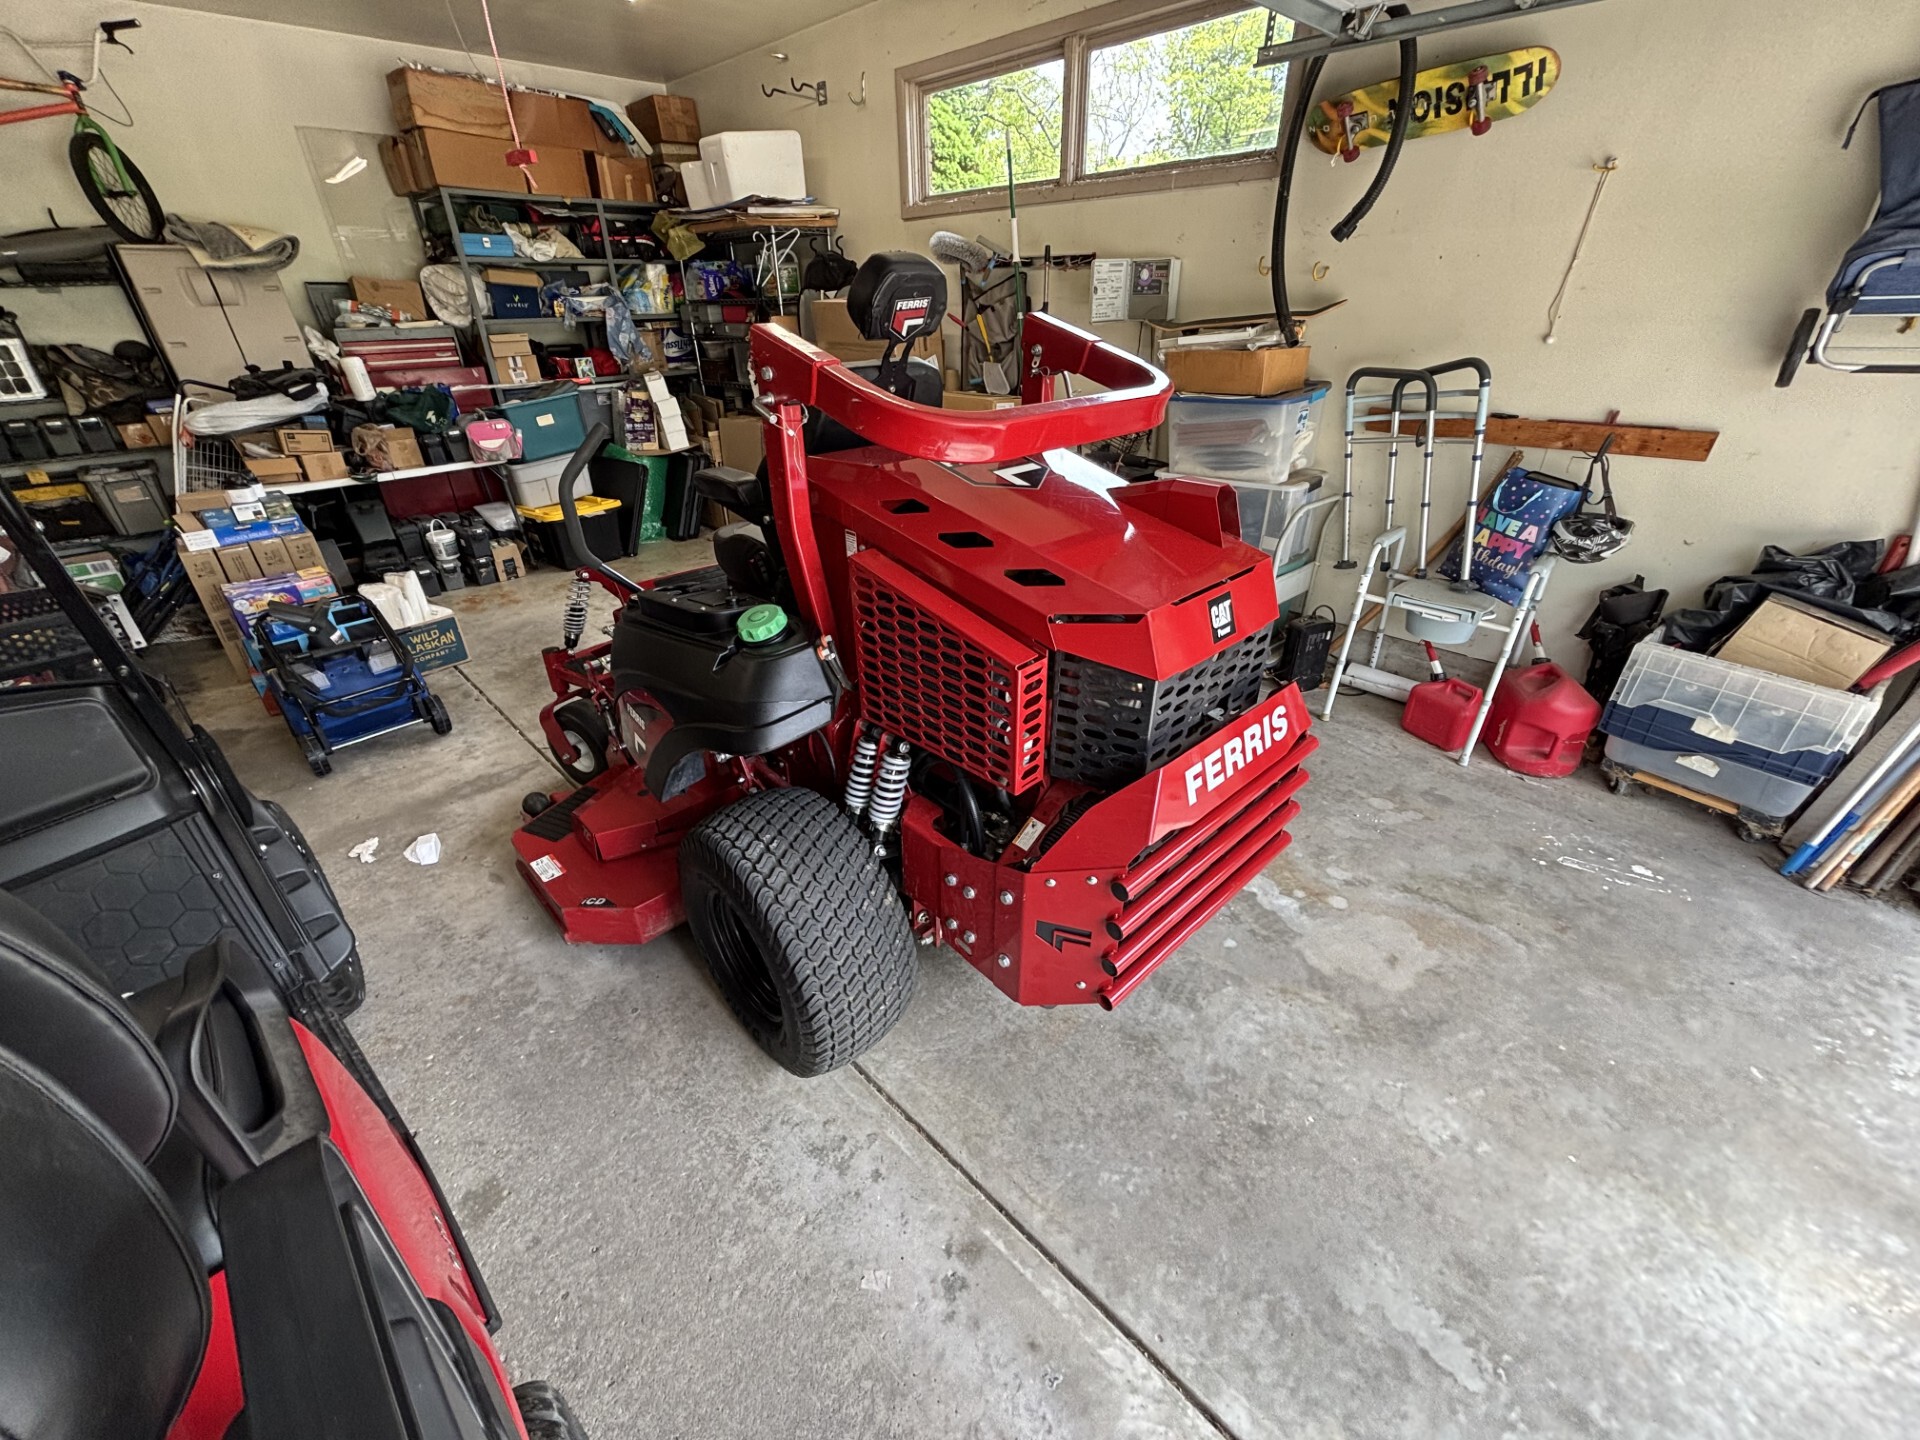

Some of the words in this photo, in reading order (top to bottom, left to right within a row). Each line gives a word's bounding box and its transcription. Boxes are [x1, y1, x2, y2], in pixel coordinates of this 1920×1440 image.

[896, 299, 929, 311] FERRIS
[1473, 524, 1533, 560] APPY
[1518, 524, 1539, 544] A
[1458, 543, 1524, 580] thday!
[1210, 598, 1232, 629] CAT
[407, 628, 457, 655] LASKAN
[409, 629, 440, 644] WILD
[414, 649, 449, 663] COMPANY
[1184, 704, 1289, 808] FERRIS
[581, 897, 607, 906] iCD
